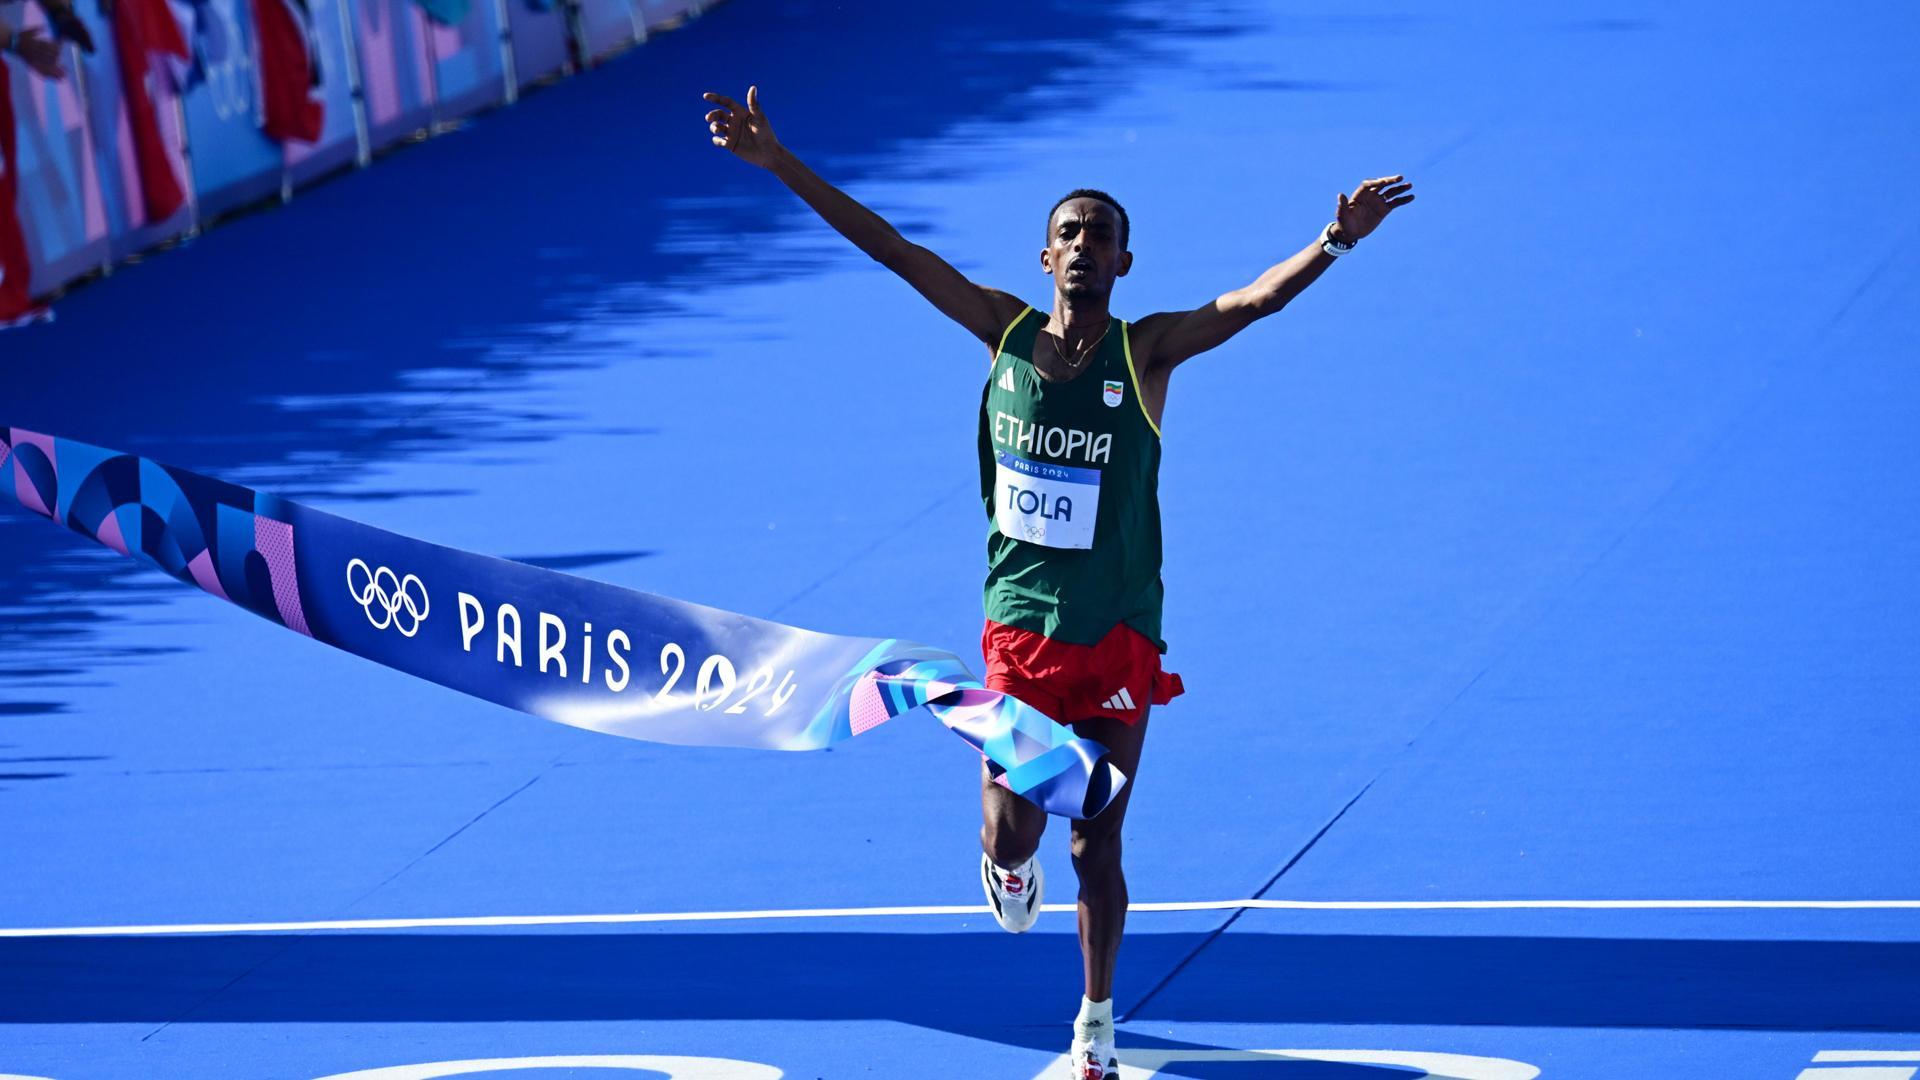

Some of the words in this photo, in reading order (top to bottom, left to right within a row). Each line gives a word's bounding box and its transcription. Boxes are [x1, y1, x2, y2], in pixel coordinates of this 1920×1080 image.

[995, 411, 1112, 463] ETHIOPIA
[1042, 467, 1069, 478] 2024
[1008, 484, 1072, 522] TOLA
[652, 642, 797, 717] 2024
